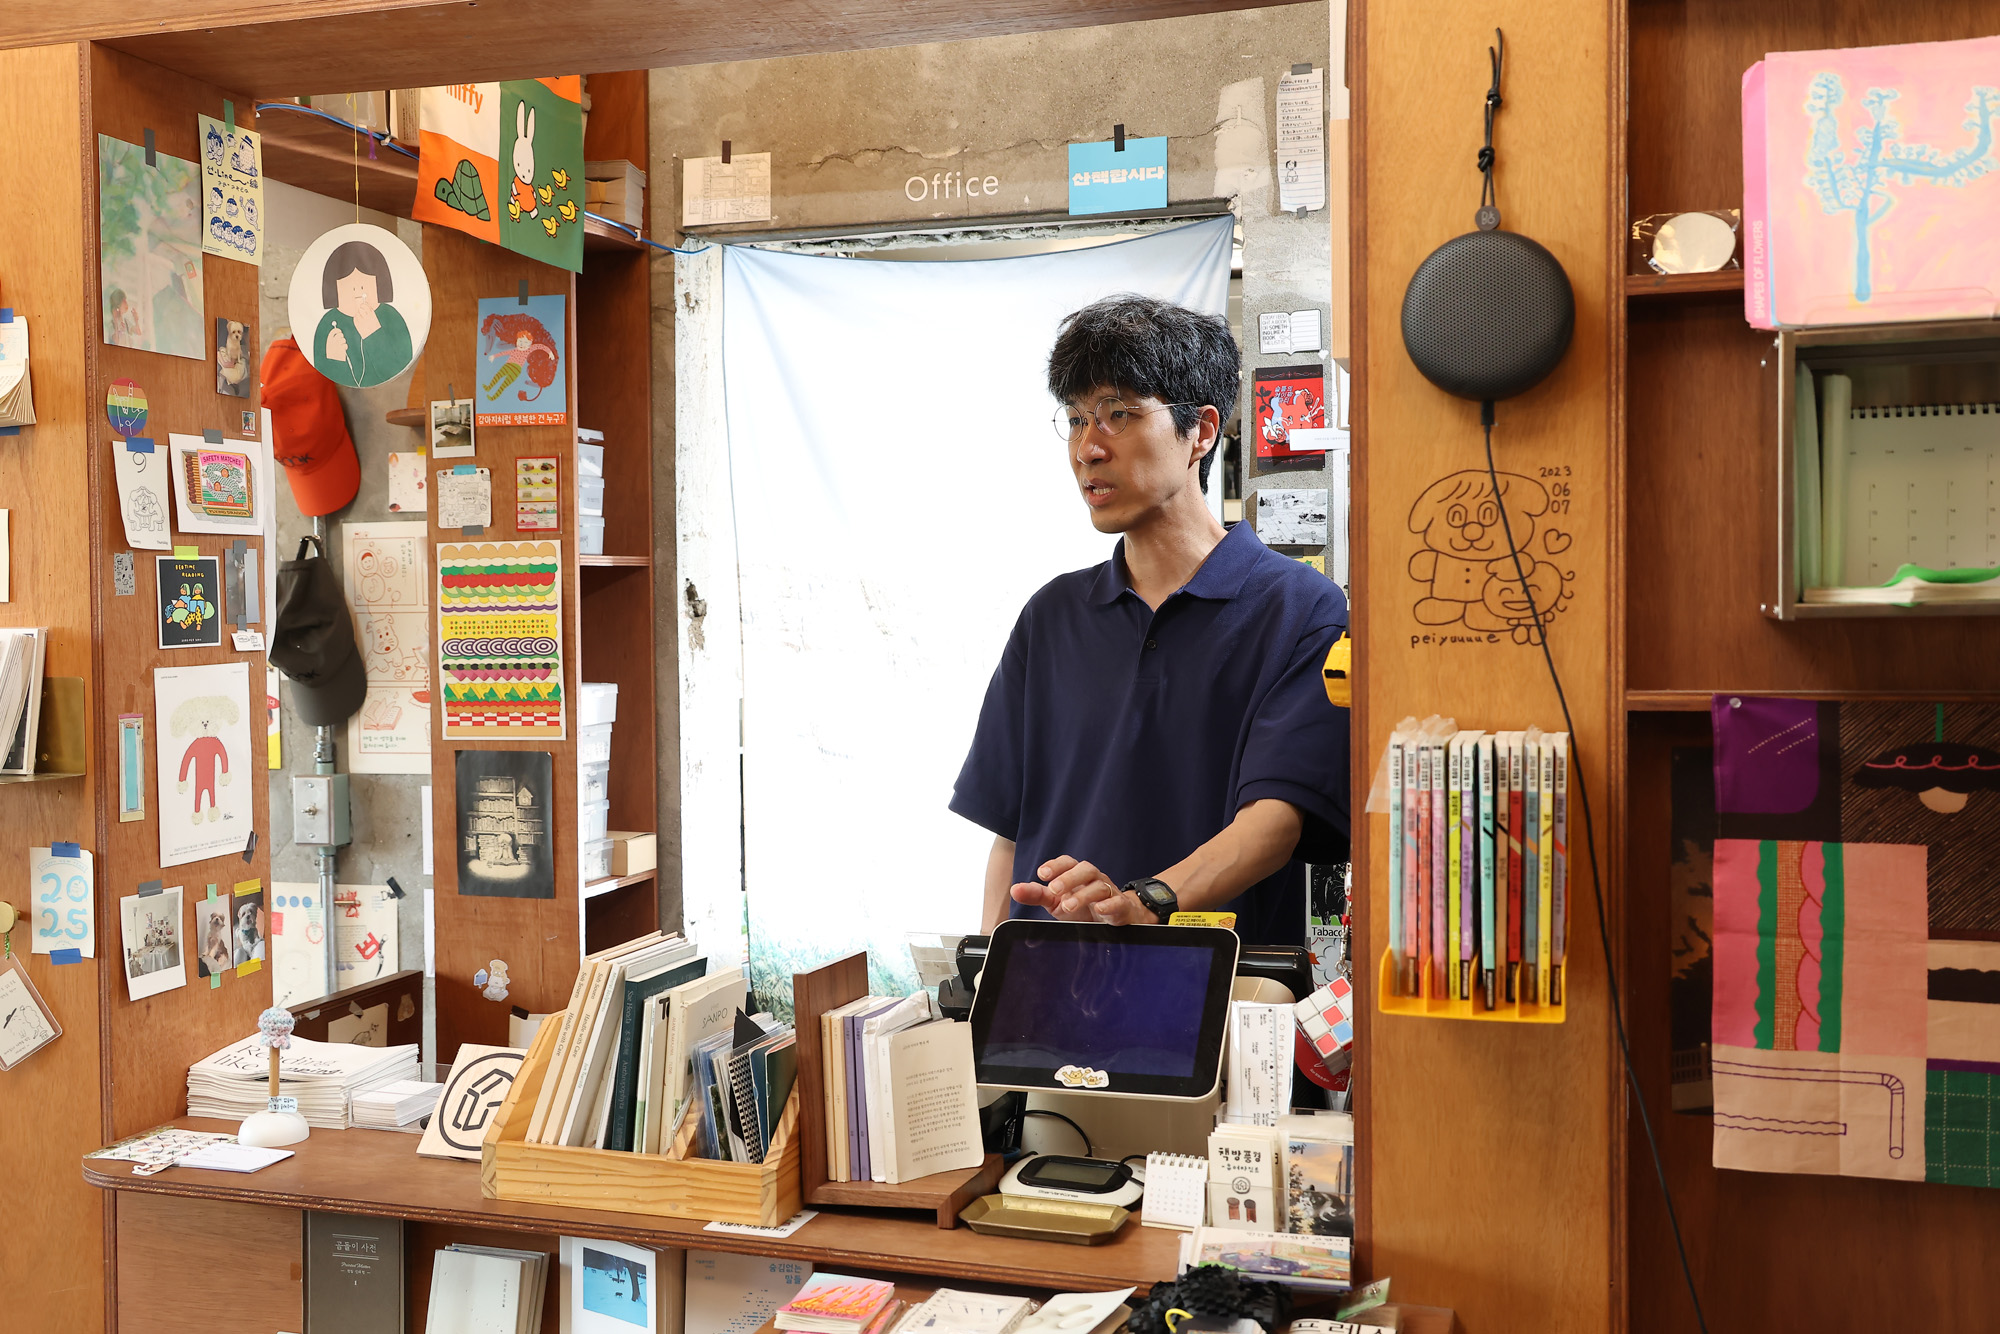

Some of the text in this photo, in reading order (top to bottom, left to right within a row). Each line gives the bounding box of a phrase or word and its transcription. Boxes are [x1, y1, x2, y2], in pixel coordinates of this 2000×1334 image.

[1072, 166, 1165, 187] 산책합시다
[904, 171, 999, 201] Office
[1753, 220, 1765, 319] SHAPES OF FLOWERS
[478, 414, 565, 425] 강아지처럼 행복한 건 누구?
[202, 455, 242, 466] SAFETY MATCHES
[1539, 466, 1572, 478] 2023
[1552, 482, 1571, 497] 06
[1551, 499, 1570, 515] 07
[41, 873, 88, 903] 20
[40, 908, 88, 940] 25
[624, 1002, 632, 1024] Honda
[702, 1008, 728, 1029] SANPO
[562, 1011, 574, 1033] Handle
[578, 1012, 590, 1034] Handle
[559, 1032, 568, 1044] with
[575, 1033, 584, 1045] with
[237, 1044, 338, 1067] Reding
[555, 1042, 564, 1057] Care
[570, 1044, 580, 1058] Care
[213, 1054, 259, 1071] like
[618, 1059, 628, 1110] Anthropophyta
[361, 1243, 377, 1253] 사전
[769, 1263, 802, 1273] 숨김없는
[1292, 1320, 1382, 1334] 프레
